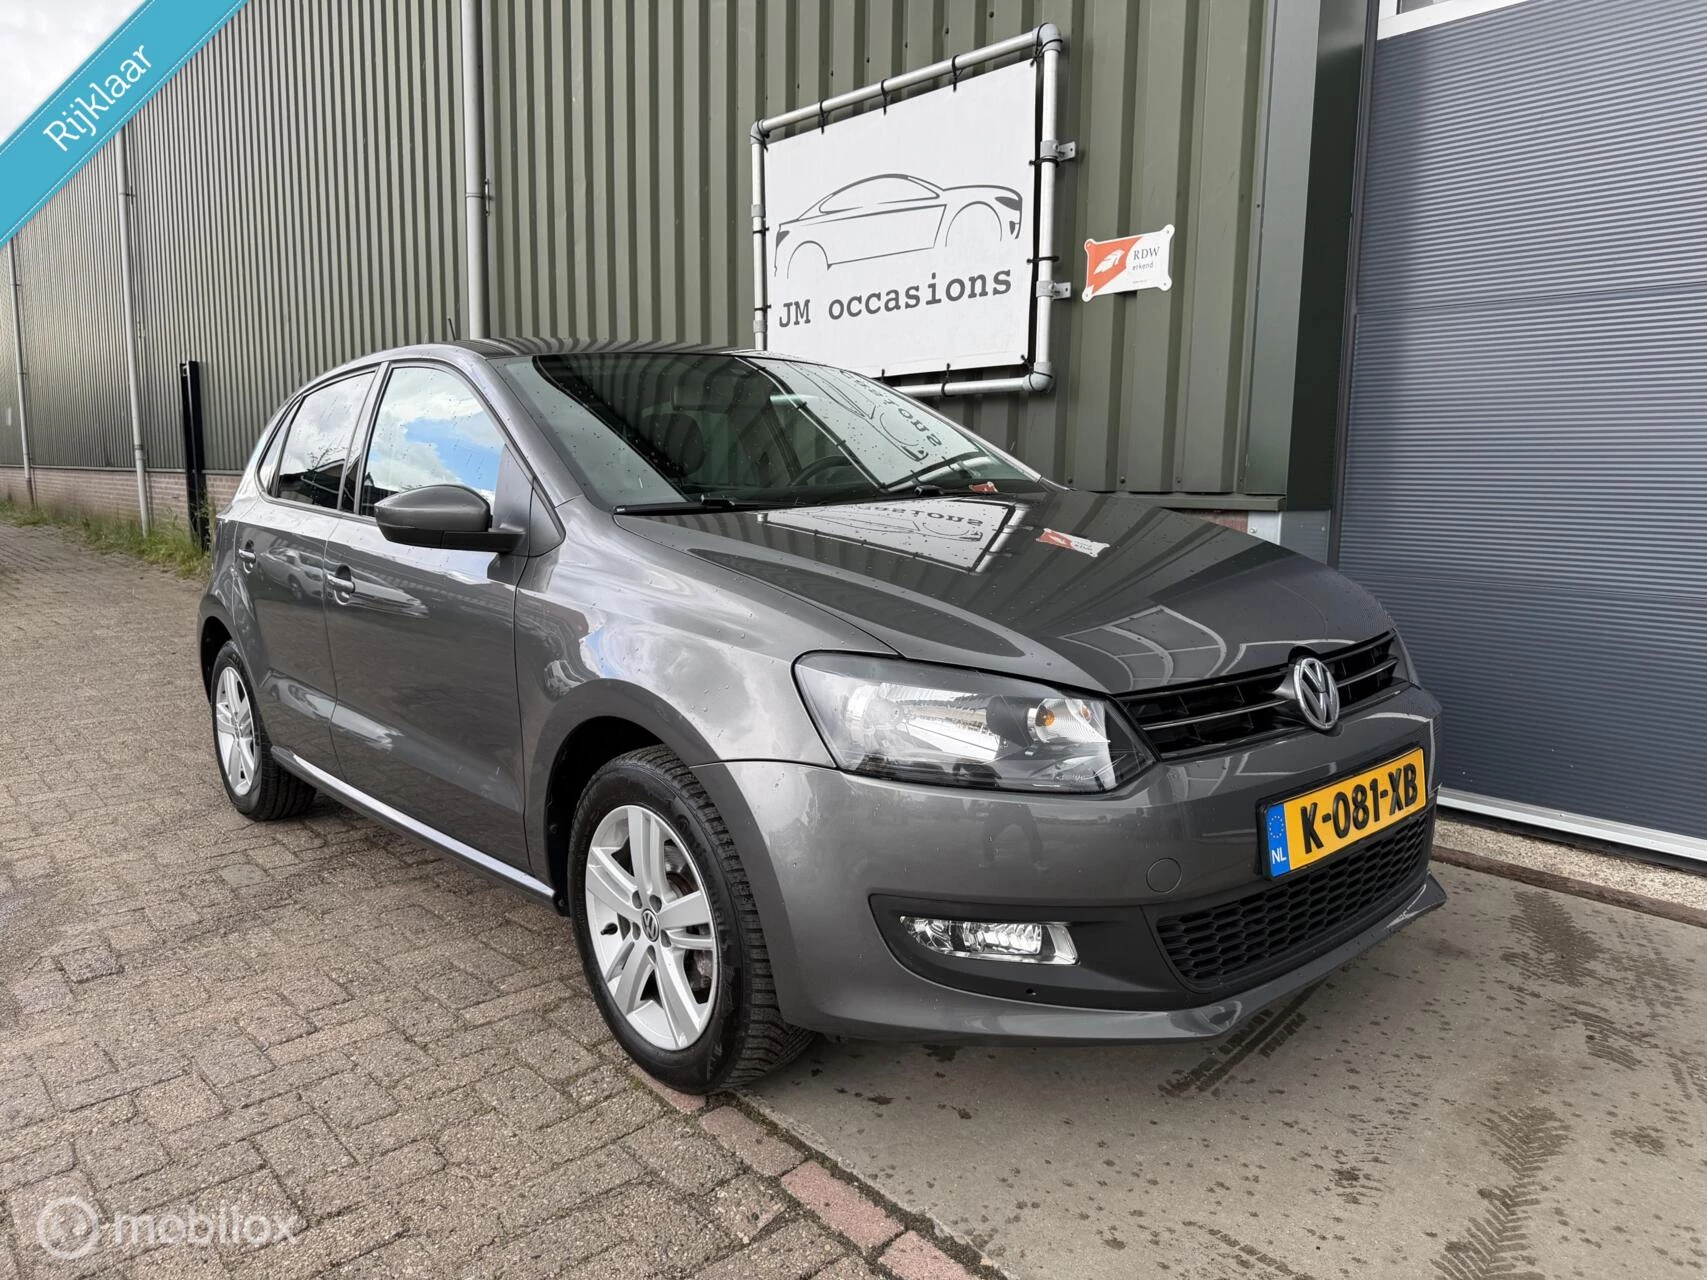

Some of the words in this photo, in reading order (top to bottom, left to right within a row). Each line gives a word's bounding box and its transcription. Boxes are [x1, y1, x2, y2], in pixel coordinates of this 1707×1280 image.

[1133, 246, 1160, 261] RDW
[778, 299, 811, 328] JM
[828, 269, 1012, 320] occasions
[1300, 763, 1418, 855] K-081-XB
[1271, 847, 1287, 864] NL
